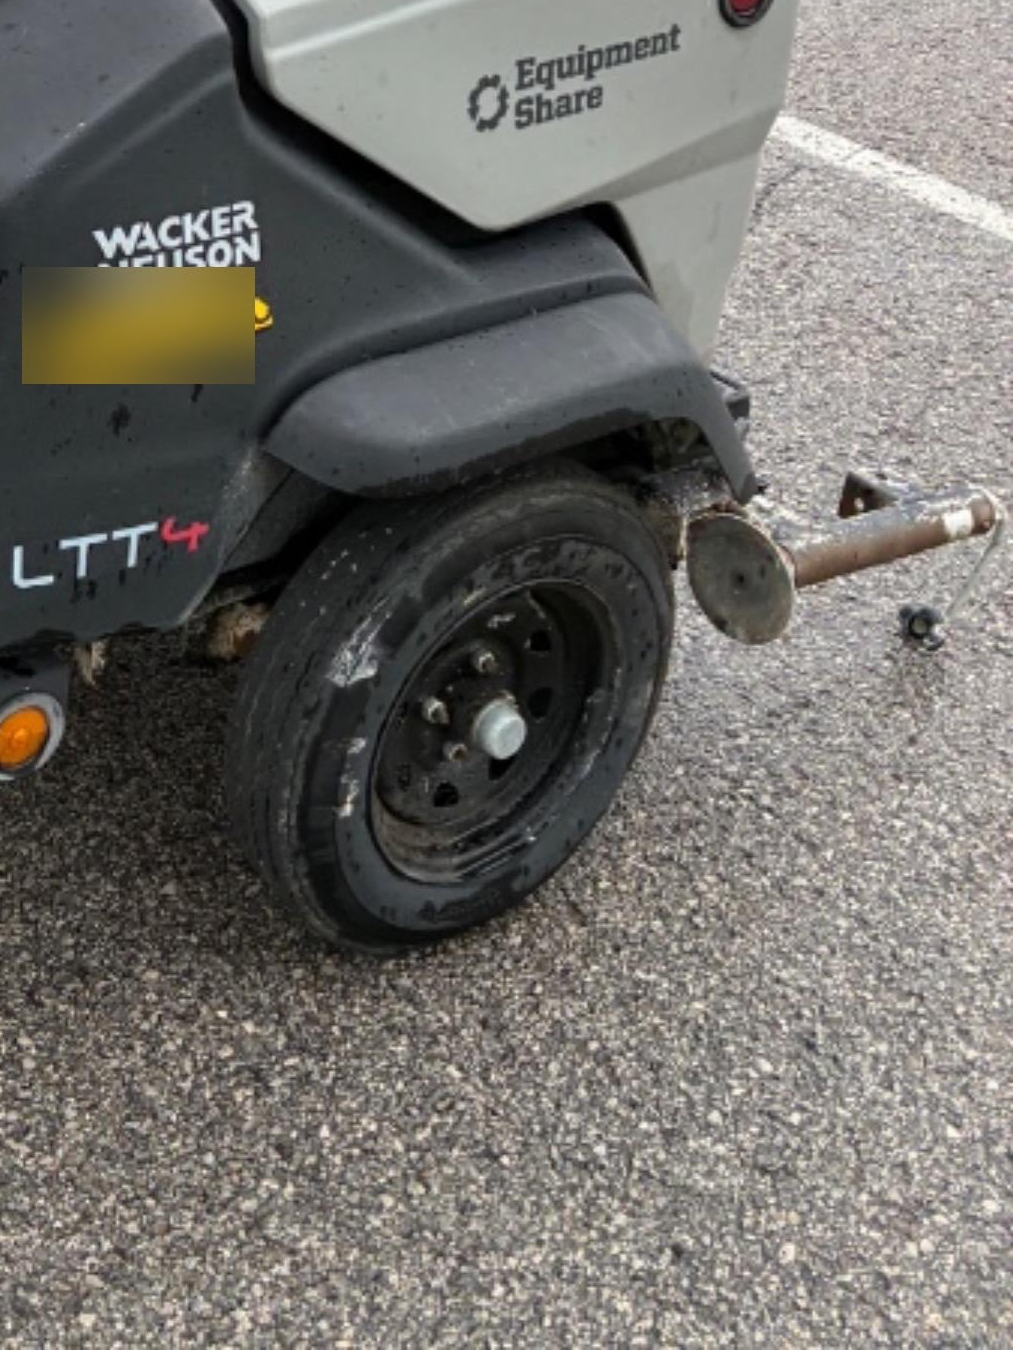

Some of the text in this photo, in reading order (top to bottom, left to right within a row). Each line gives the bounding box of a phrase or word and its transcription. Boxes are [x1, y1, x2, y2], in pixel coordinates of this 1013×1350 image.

[514, 23, 682, 91] Equipment
[514, 84, 604, 130] Share
[92, 201, 259, 259] WACKER
[12, 516, 209, 588] LTT4
